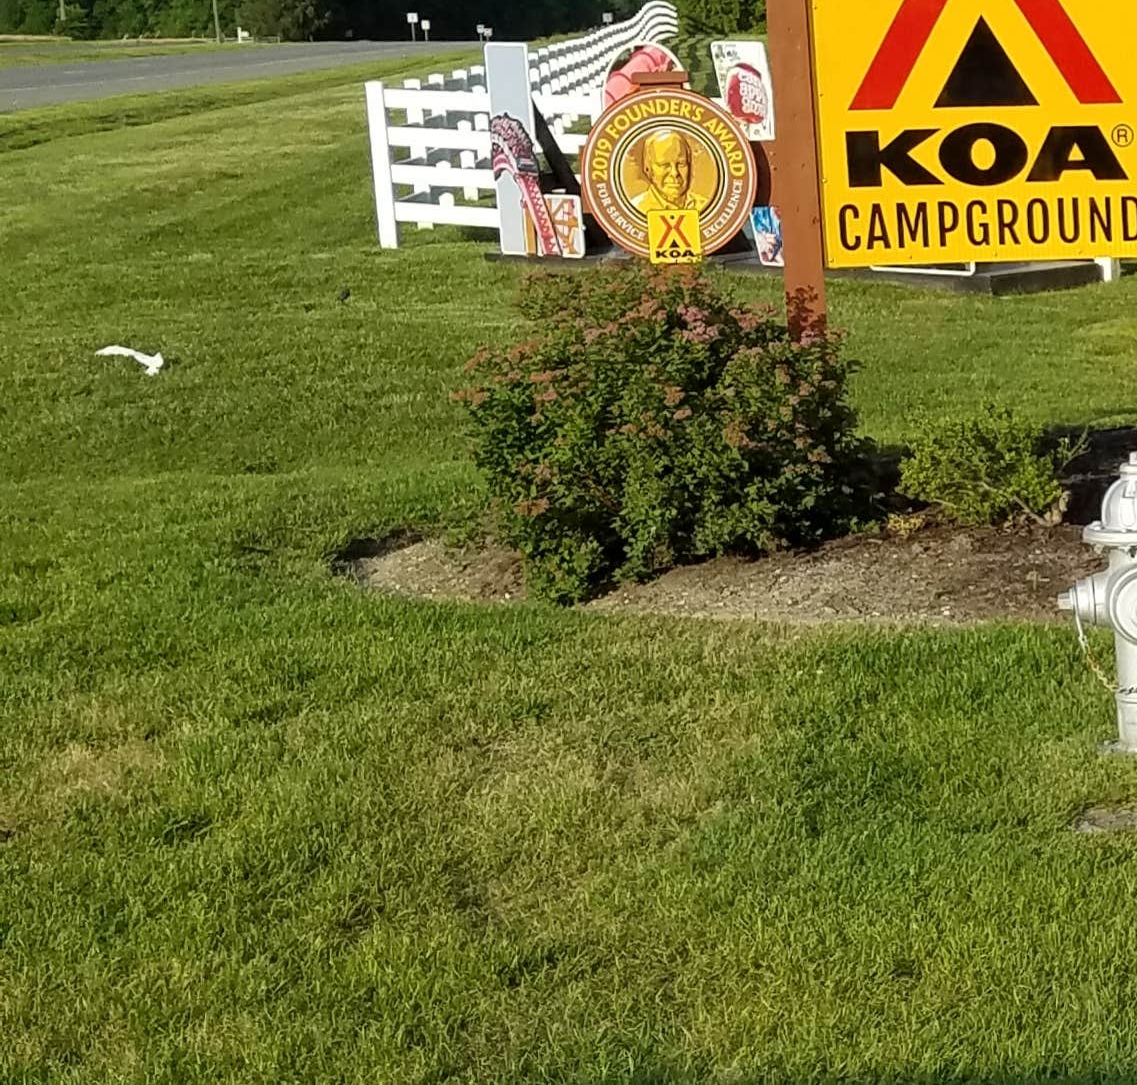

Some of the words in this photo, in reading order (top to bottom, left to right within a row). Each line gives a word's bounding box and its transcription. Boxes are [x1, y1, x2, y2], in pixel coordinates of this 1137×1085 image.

[592, 138, 613, 180] 2019
[605, 98, 704, 139] FOUNDER'S
[703, 118, 745, 177] AWARD
[597, 182, 612, 206] FOR
[606, 206, 646, 241] SERVICE
[703, 178, 743, 239] EXCELLENCE
[655, 249, 695, 259] KOA
